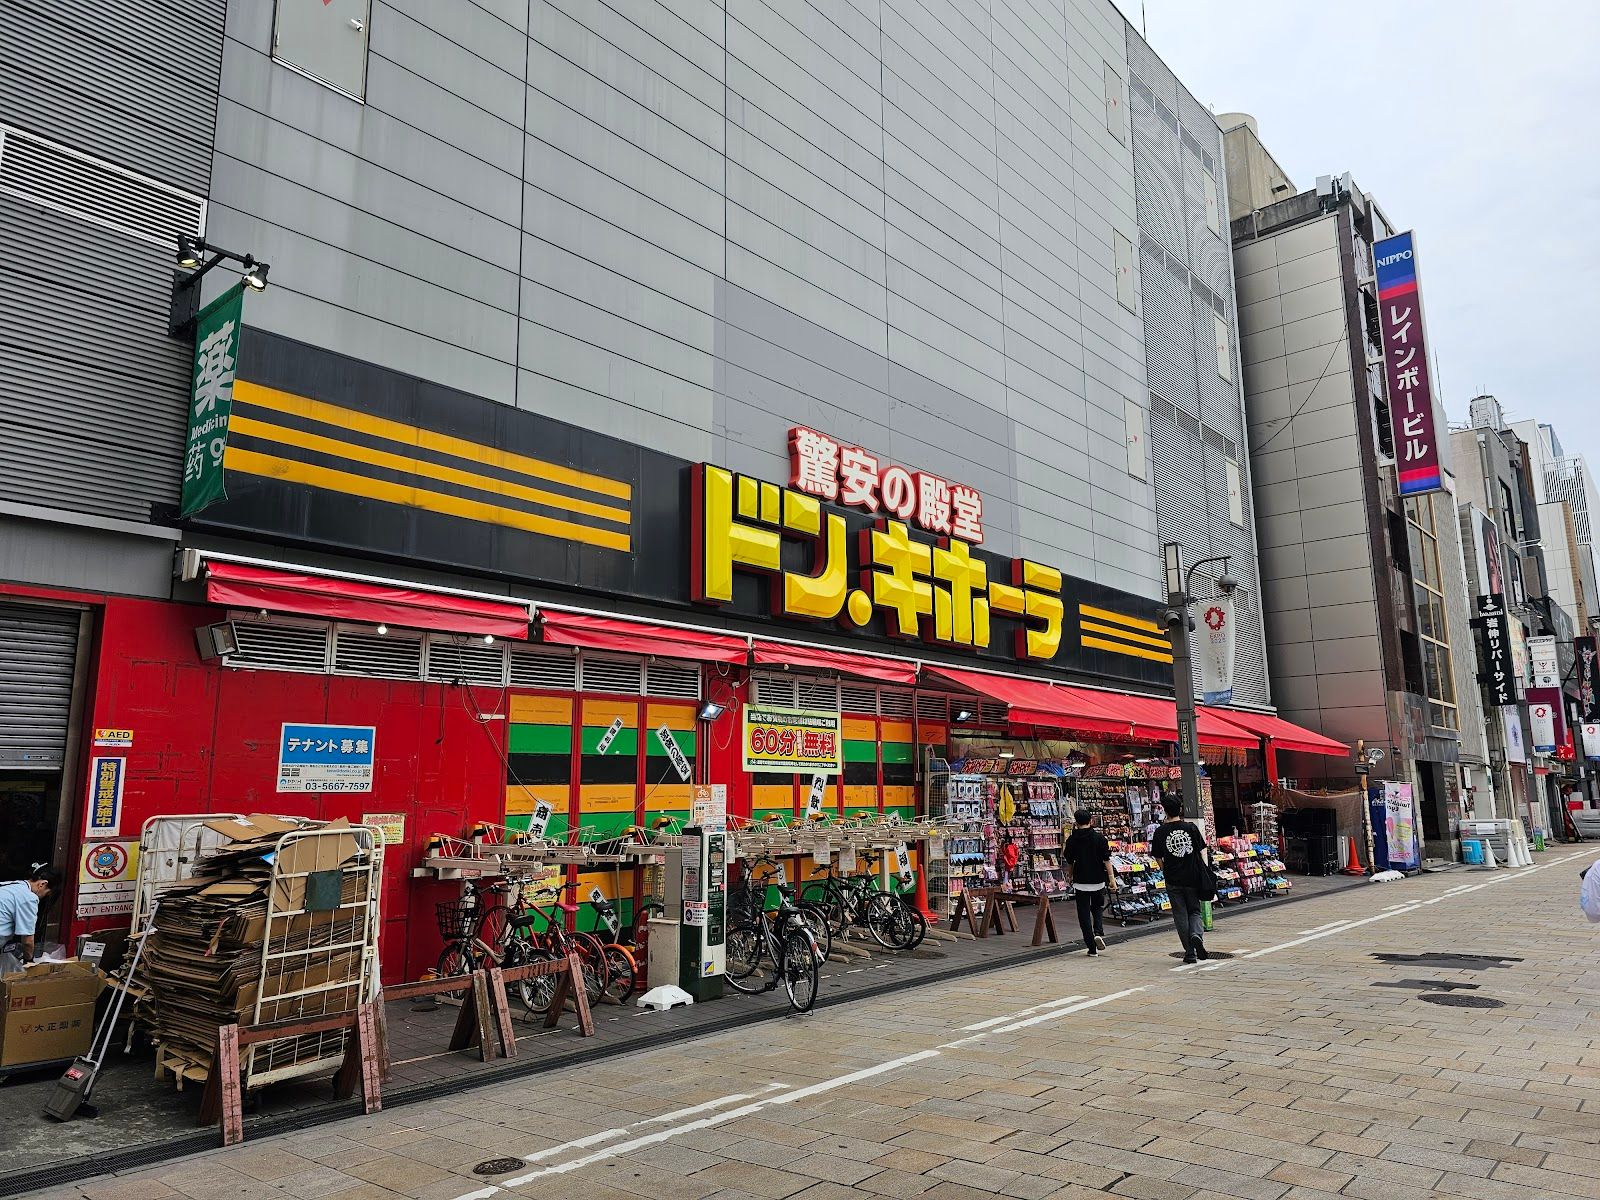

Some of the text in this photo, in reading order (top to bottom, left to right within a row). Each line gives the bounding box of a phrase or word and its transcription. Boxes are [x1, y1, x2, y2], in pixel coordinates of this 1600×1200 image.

[1376, 250, 1412, 268] NIPPO
[195, 319, 236, 418] 薬
[1390, 305, 1428, 462] レインボービル
[185, 442, 206, 482] 药
[794, 427, 983, 544] 驚安の殿堂
[287, 737, 369, 754] テナント募集
[751, 727, 797, 756] 60分
[804, 730, 836, 758] 無料
[95, 761, 117, 827] 特別警戒実施中
[305, 782, 370, 791] 03-5667-7597
[80, 906, 97, 915] EXIT
